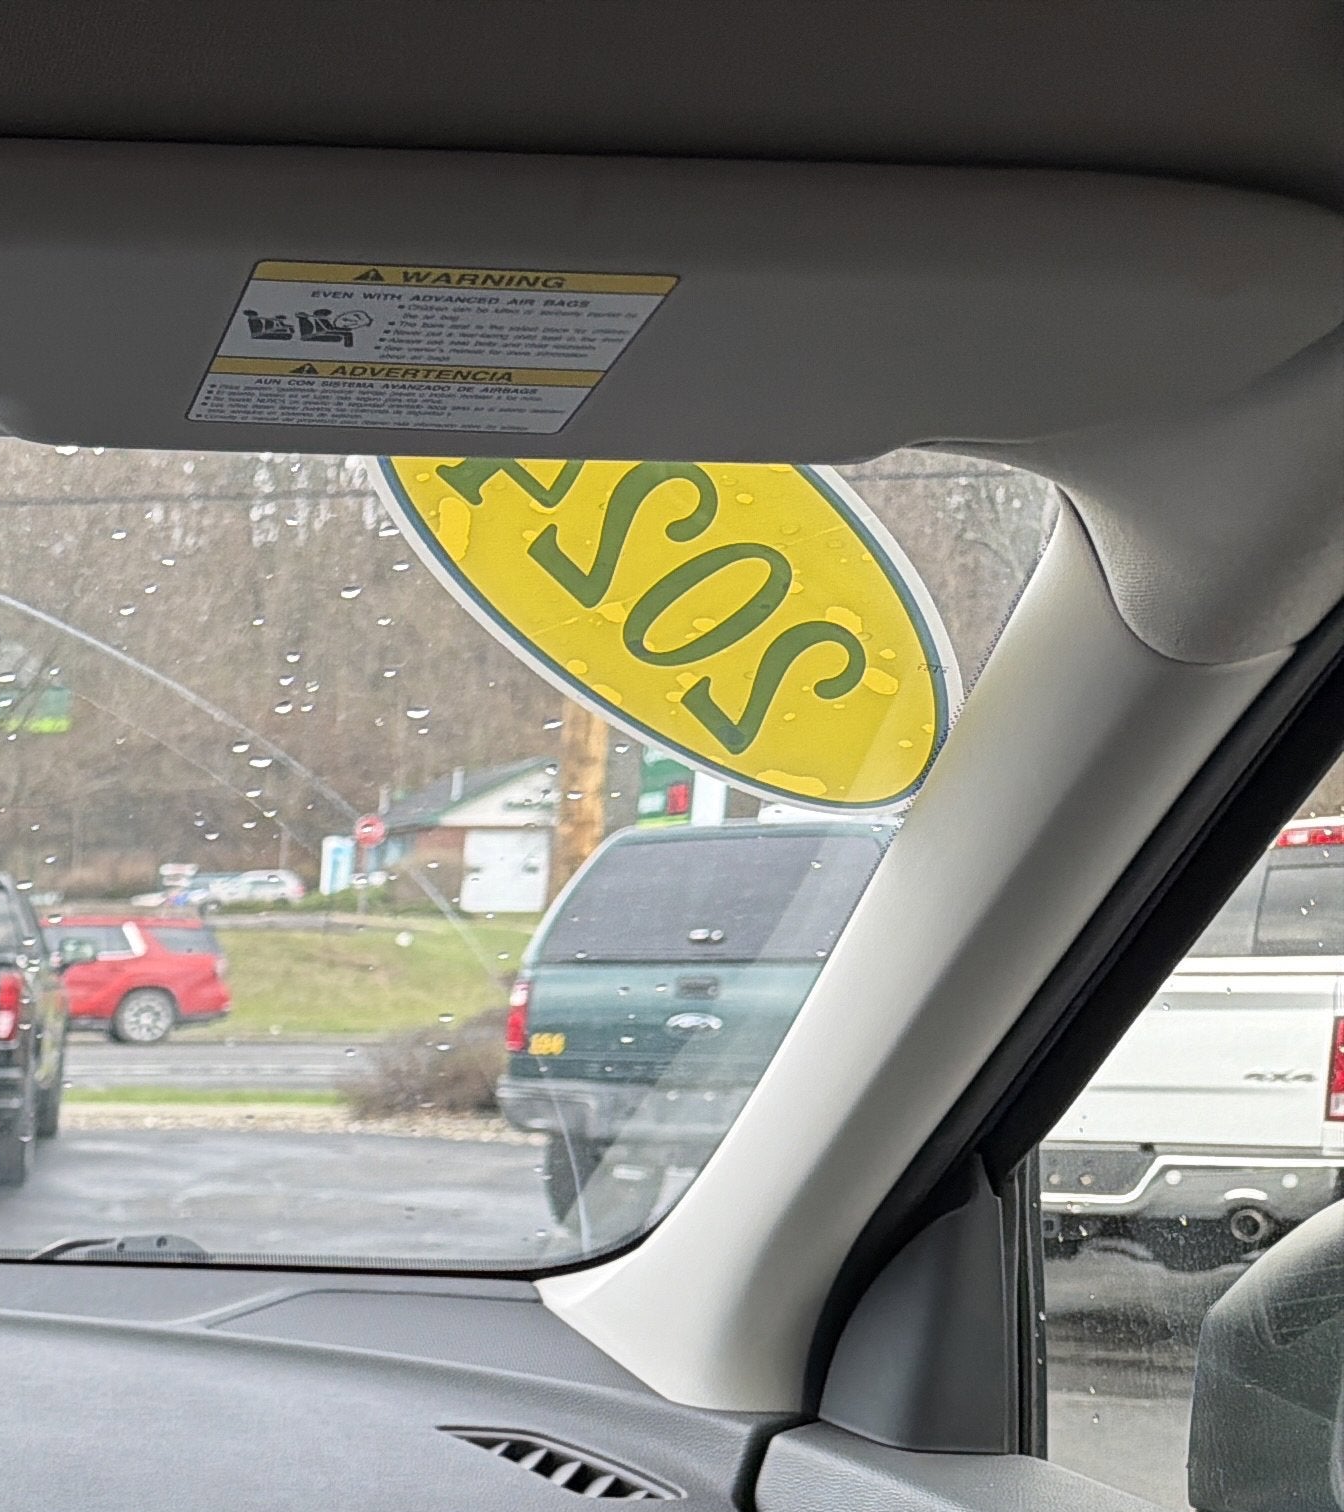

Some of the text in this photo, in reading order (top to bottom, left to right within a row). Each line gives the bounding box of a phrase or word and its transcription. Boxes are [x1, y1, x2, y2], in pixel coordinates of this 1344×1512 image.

[402, 271, 567, 289] WARNING
[311, 290, 590, 308] EVEN WITH ADVANCED AIR BAGS
[331, 365, 513, 382] ADVERTENCIA
[254, 378, 538, 395] AUN CON SISTEMA AVANZADO DE AIRBAGS
